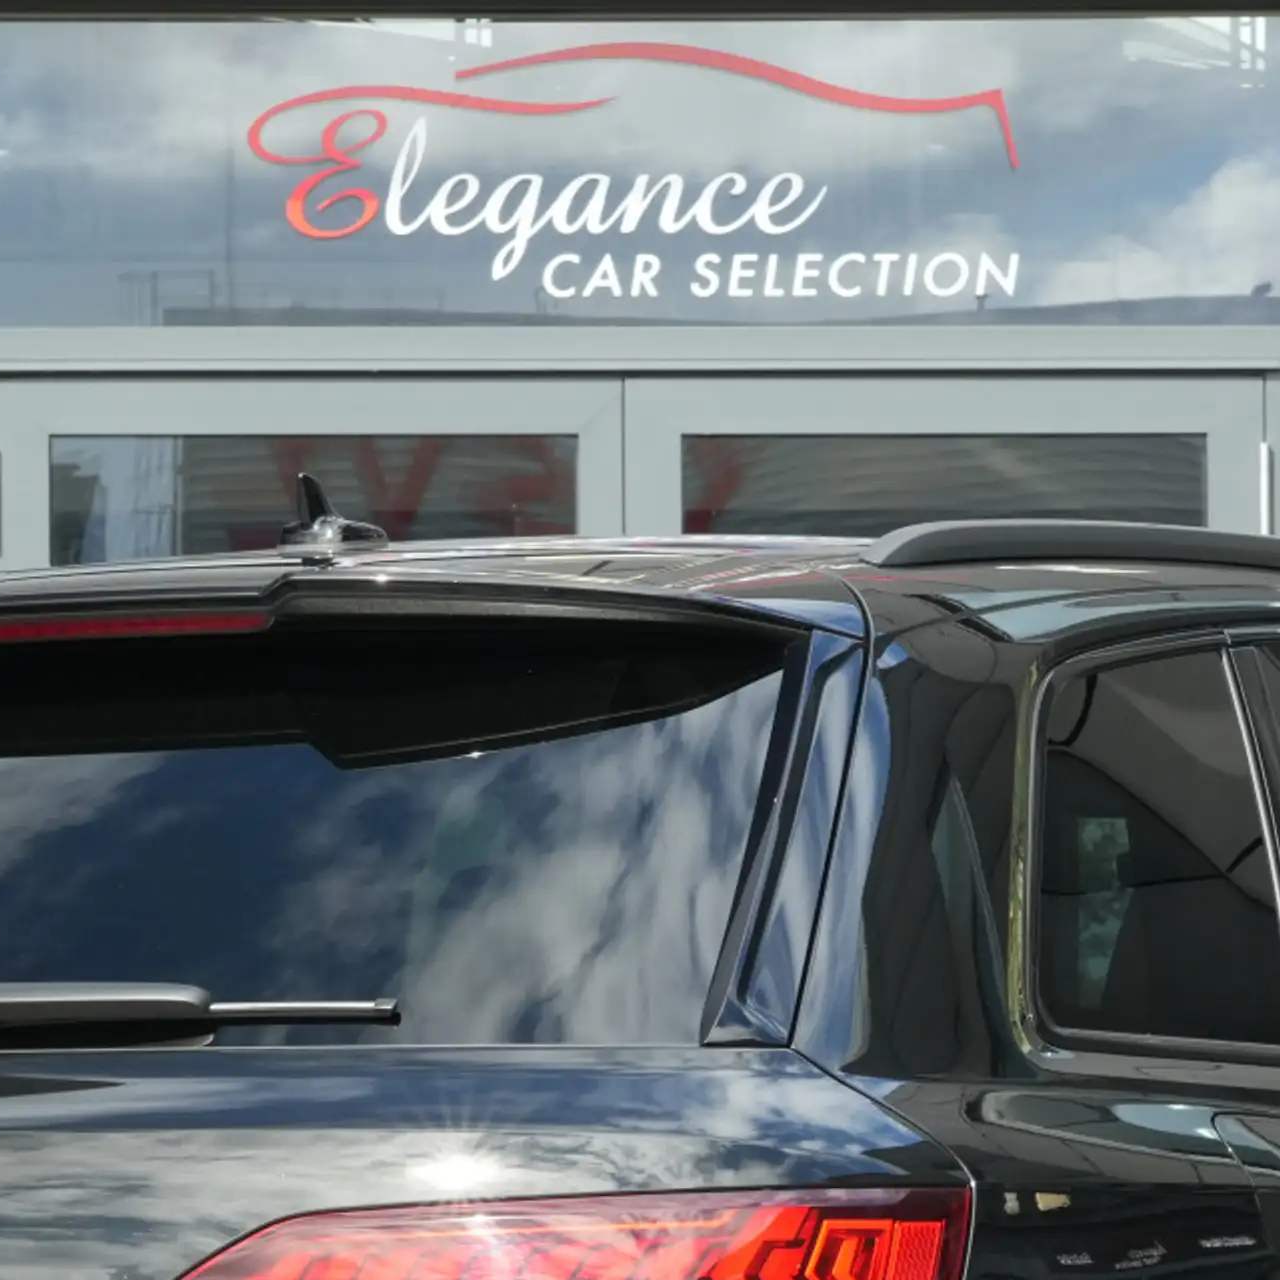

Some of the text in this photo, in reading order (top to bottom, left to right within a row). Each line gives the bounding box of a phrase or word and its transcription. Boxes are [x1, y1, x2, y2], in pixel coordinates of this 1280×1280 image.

[248, 88, 827, 281] Elegance
[542, 251, 1020, 298] CAR SELECTION
